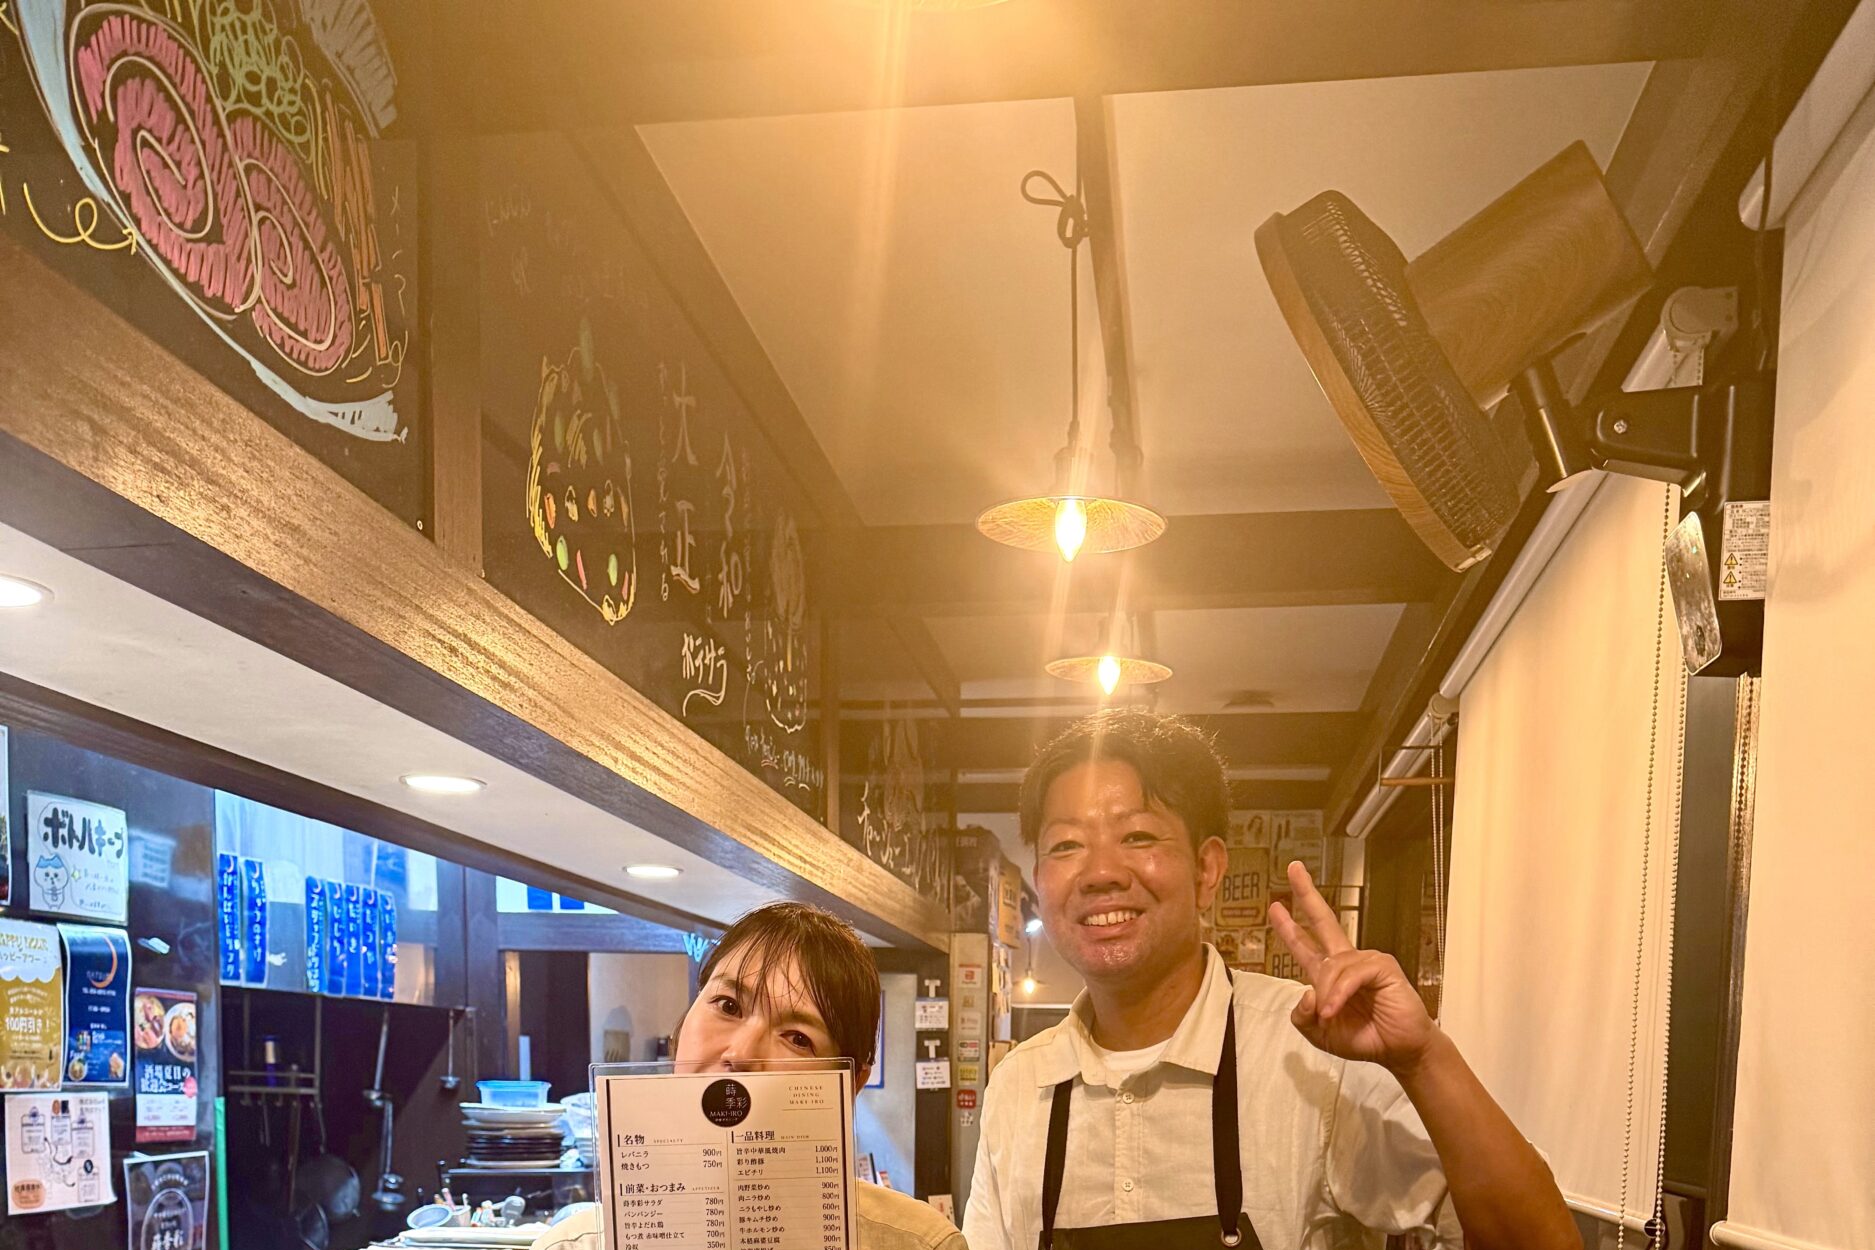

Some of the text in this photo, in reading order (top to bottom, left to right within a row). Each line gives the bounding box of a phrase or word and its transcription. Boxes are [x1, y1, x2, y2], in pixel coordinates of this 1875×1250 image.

[1222, 871, 1260, 903] BEER
[1272, 952, 1303, 979] BEE
[624, 1134, 645, 1145] 名物
[735, 1130, 775, 1141] 一品料理
[815, 1145, 838, 1153] 1,000円
[621, 1148, 722, 1159] レバニラ 900円
[815, 1156, 839, 1164] 1,100円
[621, 1160, 723, 1171] 焼きもつ 750円
[815, 1166, 839, 1174] 1,100円
[625, 1182, 686, 1194] 前菜・おつまみ
[821, 1181, 839, 1189] 900円
[705, 1197, 724, 1205] 780円
[705, 1208, 725, 1216] 780円
[822, 1213, 841, 1221] 900円
[706, 1219, 725, 1227] 780円
[823, 1224, 841, 1232] 900円
[706, 1230, 725, 1238] 700円
[823, 1234, 841, 1242] 900円
[707, 1241, 726, 1249] 350円
